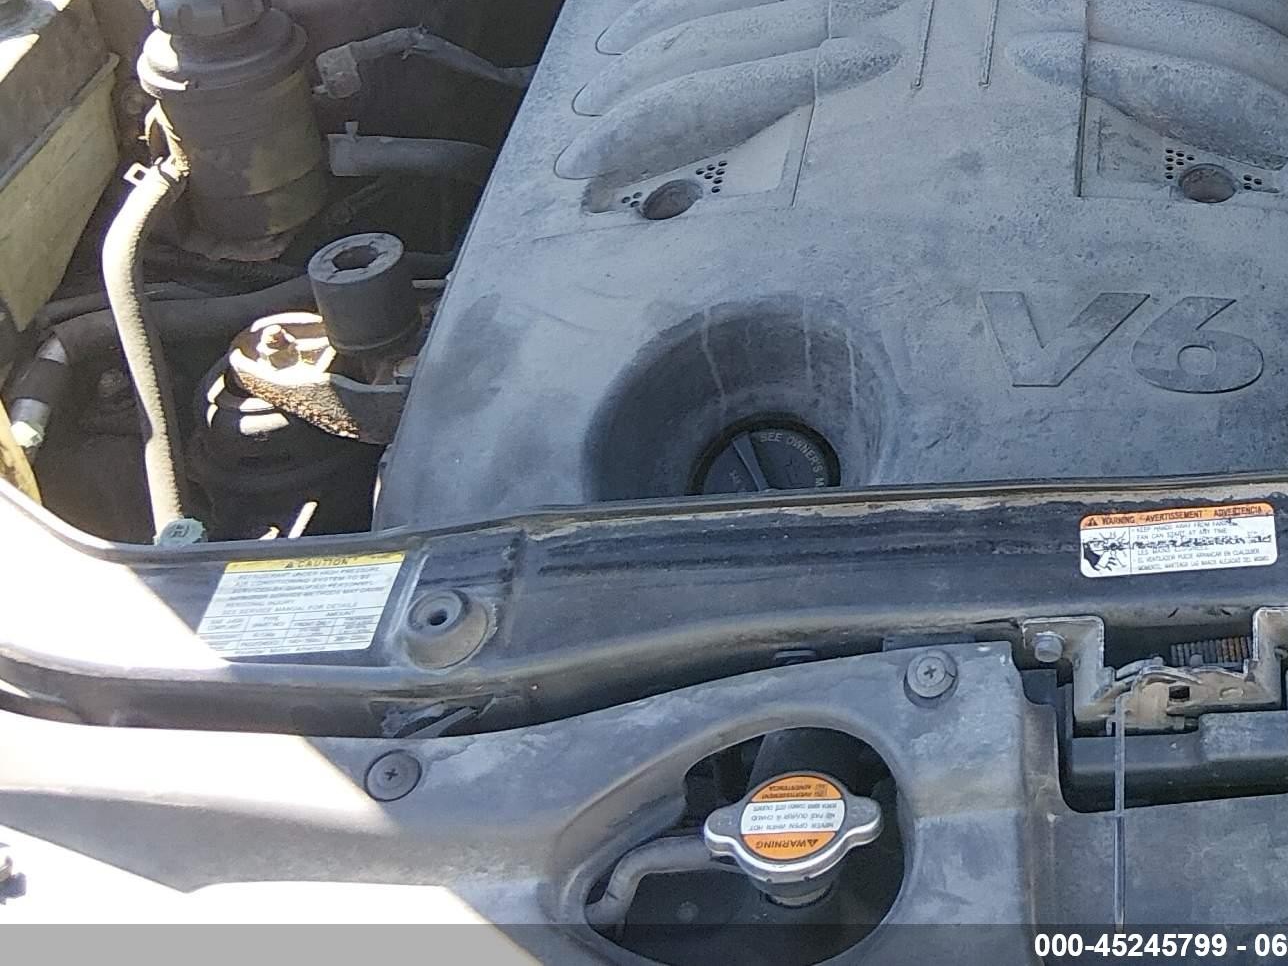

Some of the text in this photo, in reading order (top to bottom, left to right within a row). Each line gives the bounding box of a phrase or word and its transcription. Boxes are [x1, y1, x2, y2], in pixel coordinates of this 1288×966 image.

[980, 291, 1264, 394] V6
[760, 432, 783, 443] SEE
[1102, 516, 1135, 525] WARNING
[1145, 511, 1202, 522] AVERTISSEMENT
[298, 558, 349, 568] CAUTION
[755, 839, 805, 849] WARNING
